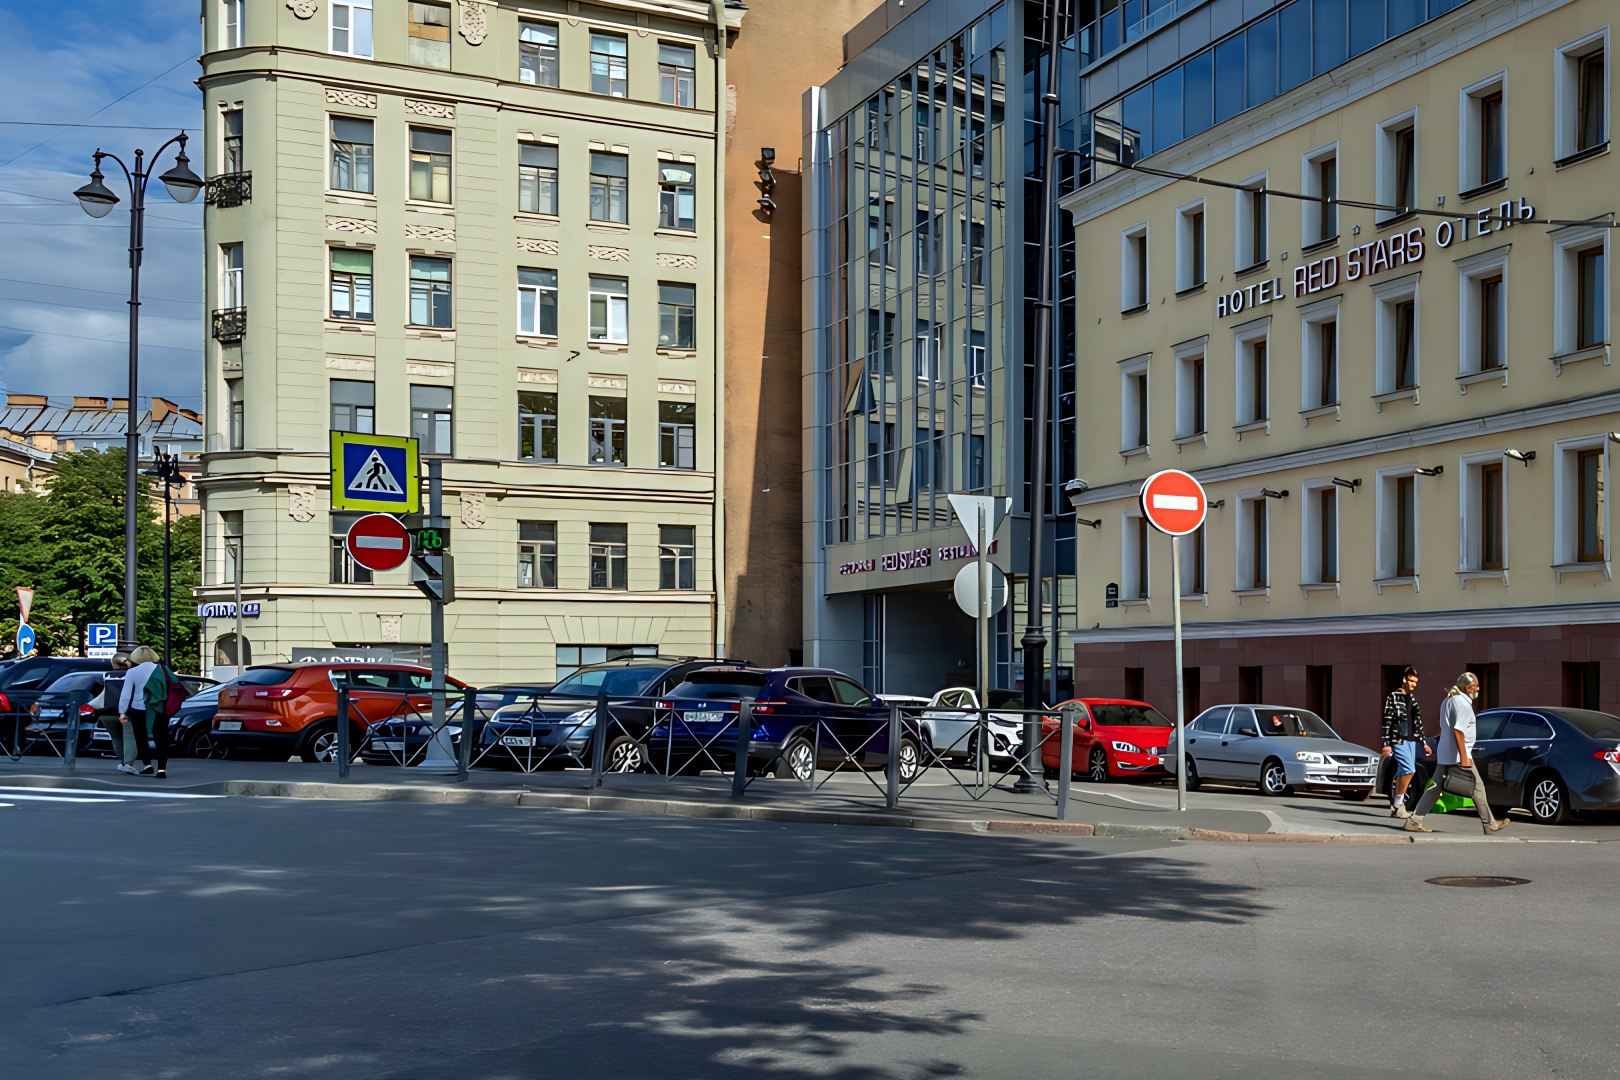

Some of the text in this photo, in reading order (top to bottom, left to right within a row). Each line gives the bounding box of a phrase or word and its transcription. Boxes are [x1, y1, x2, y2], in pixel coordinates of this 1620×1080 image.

[1435, 197, 1535, 248] ОТЕЛЬ
[1217, 226, 1426, 318] HOTEL RED STARS
[96, 626, 111, 645] P
